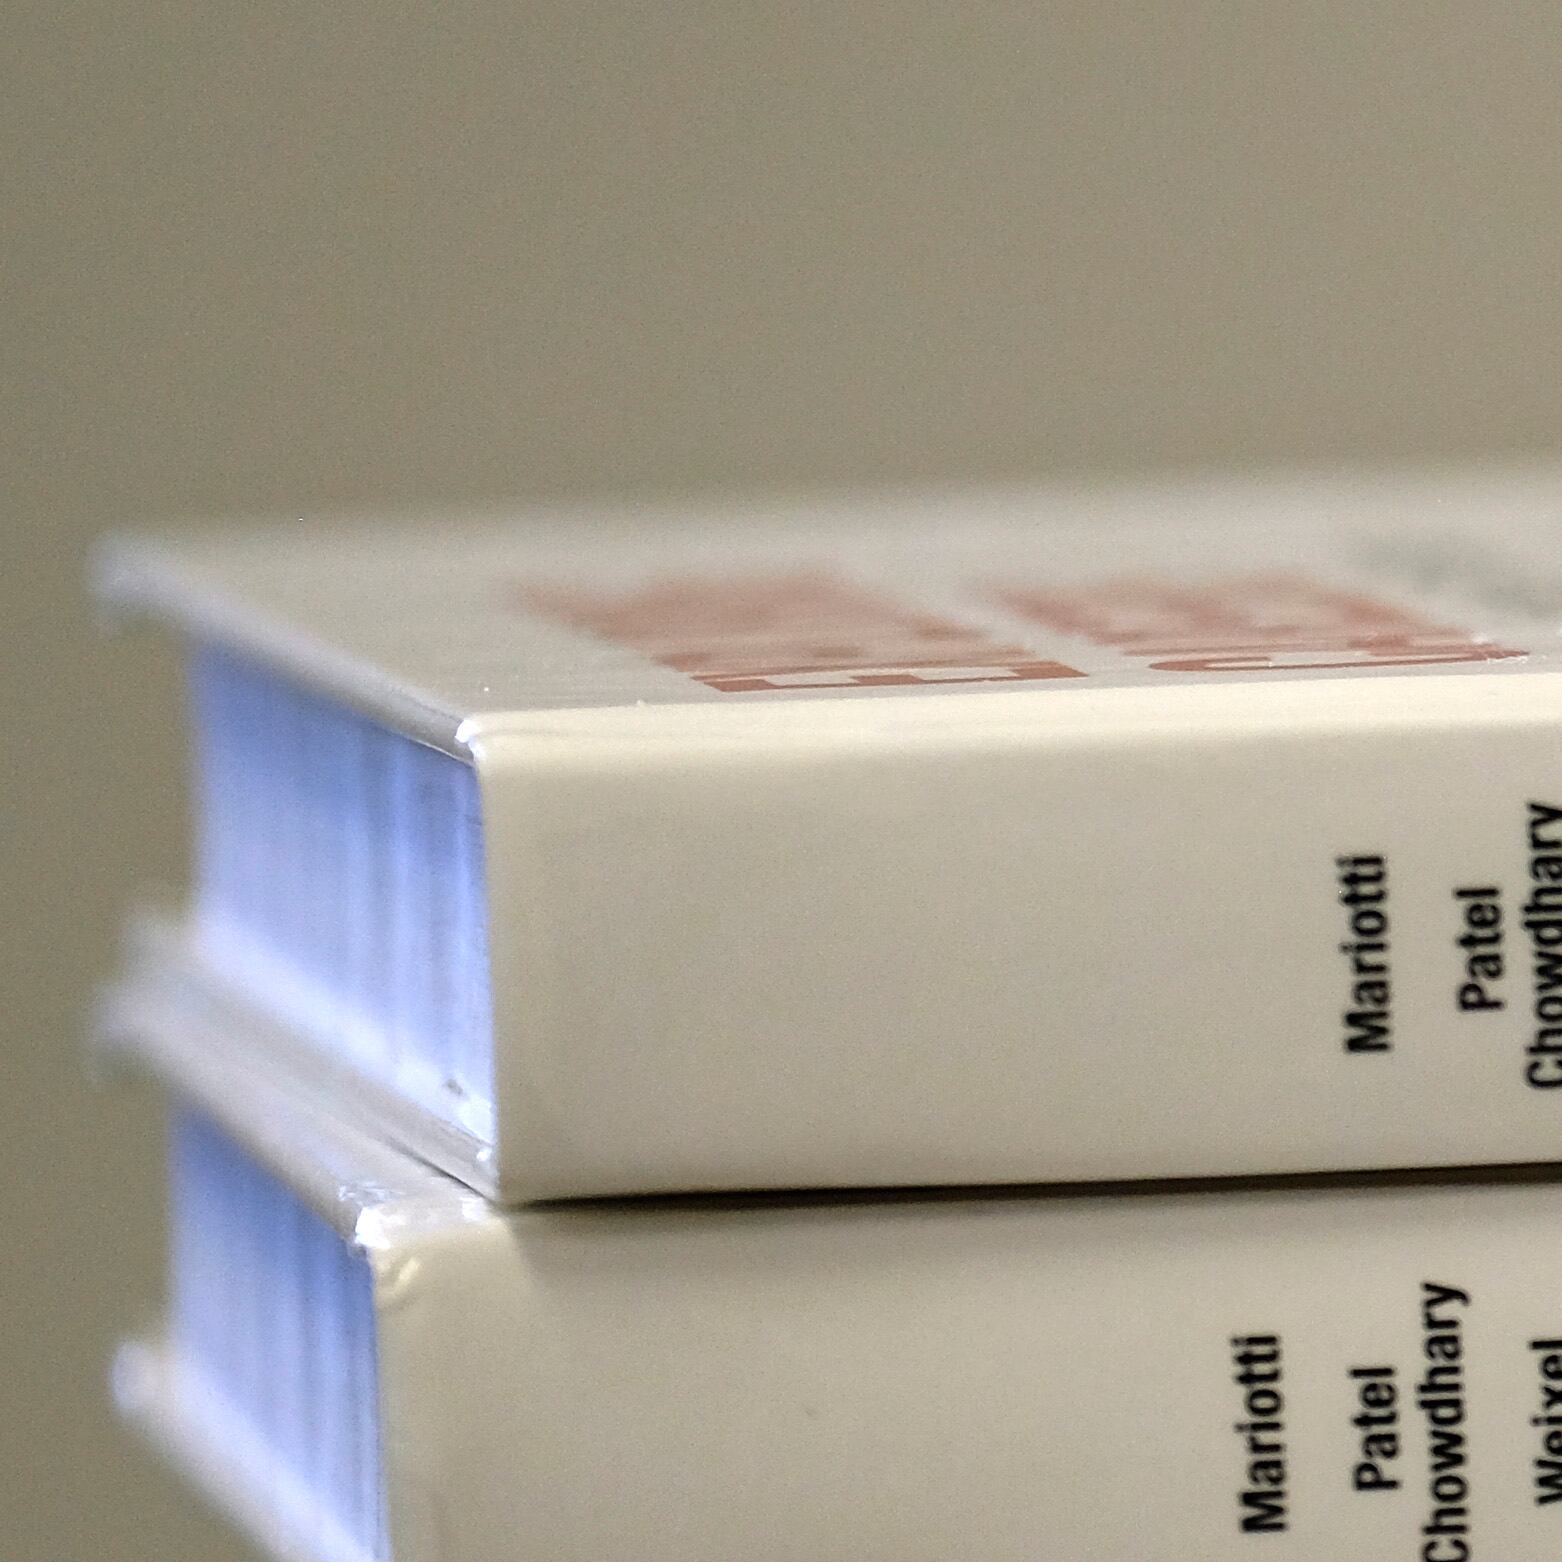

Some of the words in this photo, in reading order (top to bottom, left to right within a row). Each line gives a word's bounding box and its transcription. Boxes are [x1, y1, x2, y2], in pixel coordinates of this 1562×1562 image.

[1337, 855, 1392, 1054] Mariotti
[1455, 887, 1504, 1012] Patel
[1232, 1335, 1287, 1534] Mariotti
[1350, 1367, 1401, 1492] Patel
